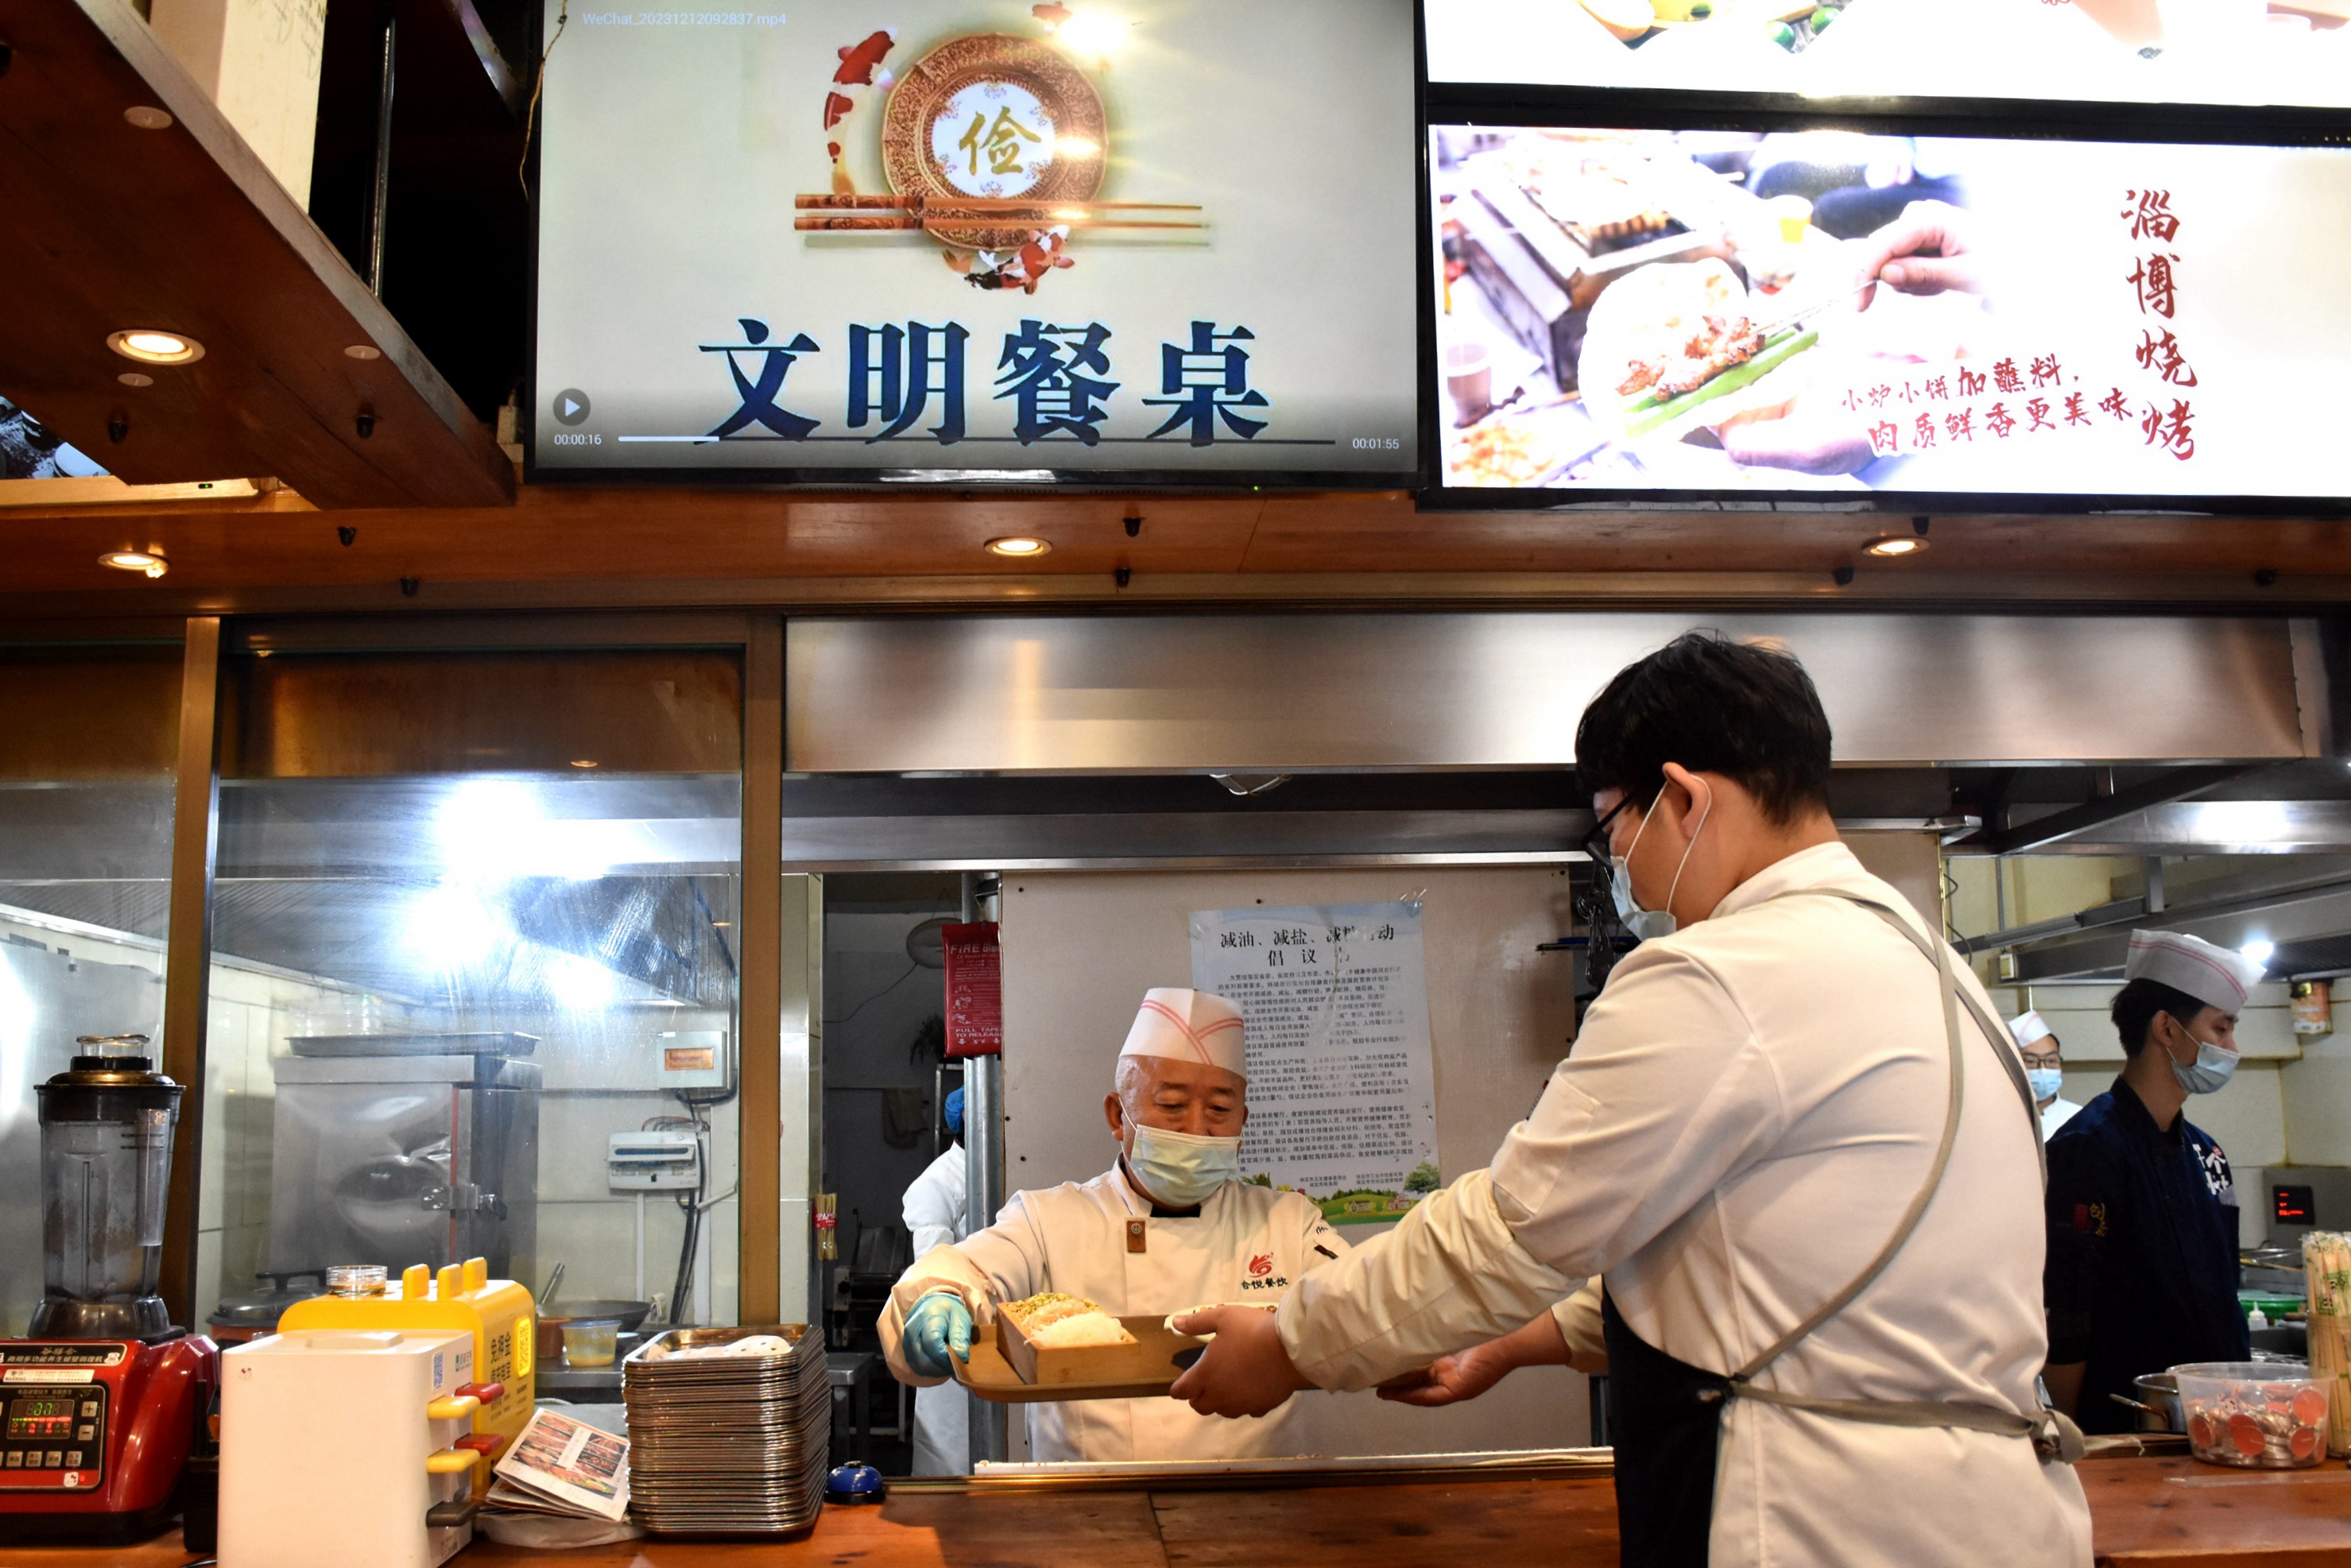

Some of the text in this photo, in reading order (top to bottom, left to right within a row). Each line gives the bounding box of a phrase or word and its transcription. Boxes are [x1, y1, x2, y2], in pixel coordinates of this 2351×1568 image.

[583, 13, 787, 26] WeChat_20231212092837.mp4
[2121, 189, 2198, 461] 淄博烧烤
[695, 318, 1272, 448] 文明餐桌
[554, 434, 602, 445] 00:00:16
[1868, 387, 2133, 453] 肉质鲜香更美味
[1353, 438, 1400, 449] 00:01:55
